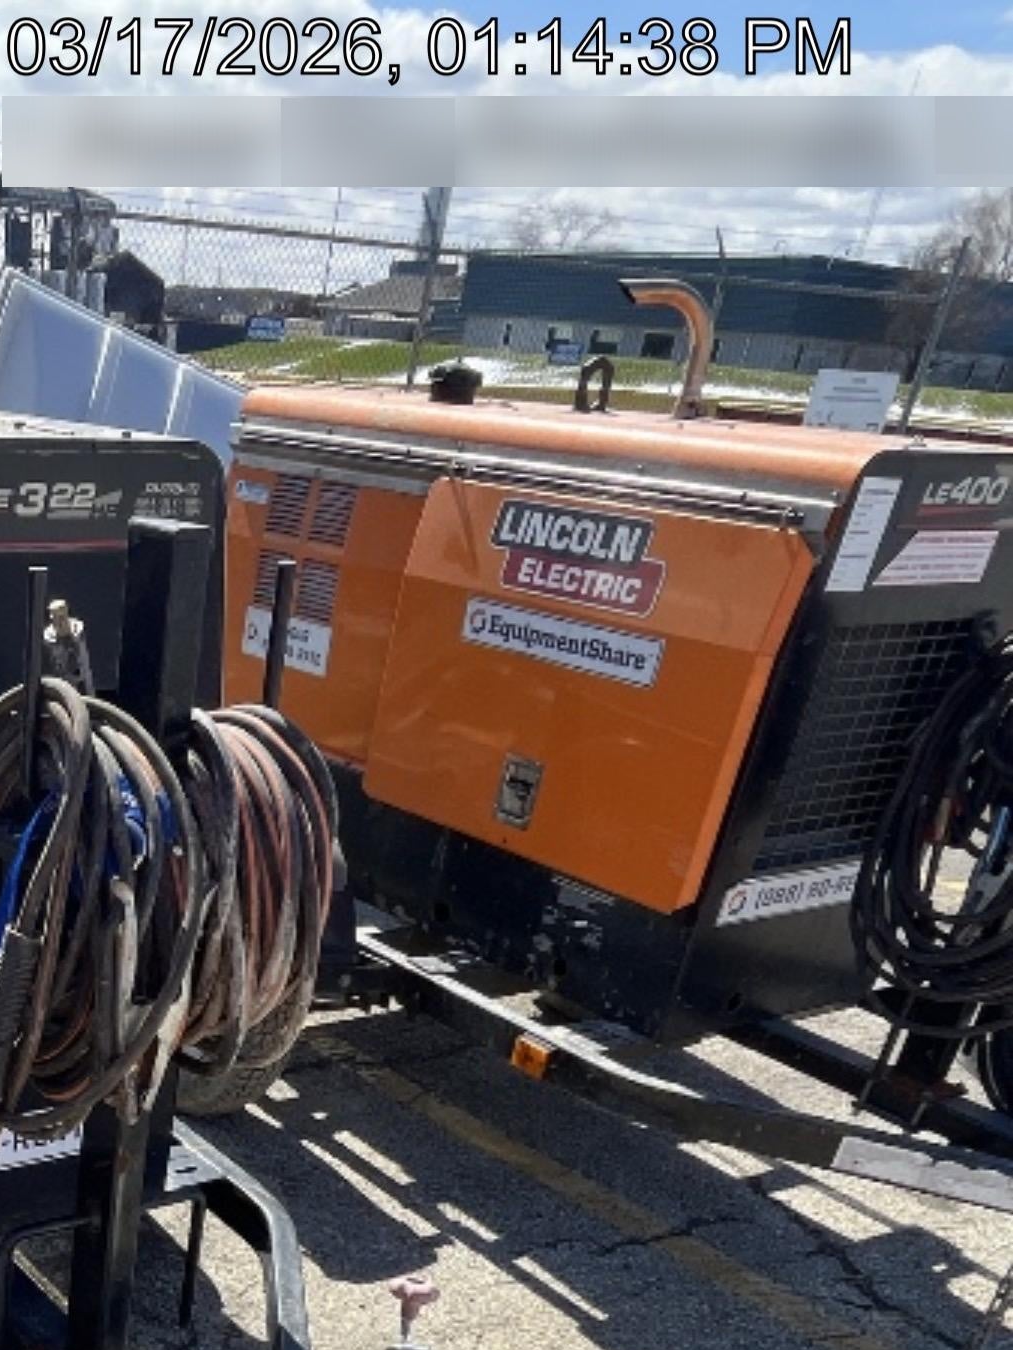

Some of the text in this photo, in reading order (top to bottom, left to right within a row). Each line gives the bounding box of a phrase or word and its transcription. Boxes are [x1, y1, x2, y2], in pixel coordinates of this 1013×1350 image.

[14, 481, 97, 517] 322
[922, 476, 1010, 505] LE400
[499, 505, 642, 562] LINCOLN
[517, 556, 642, 604] ELECTRIC
[487, 613, 647, 671] EquipmentShare
